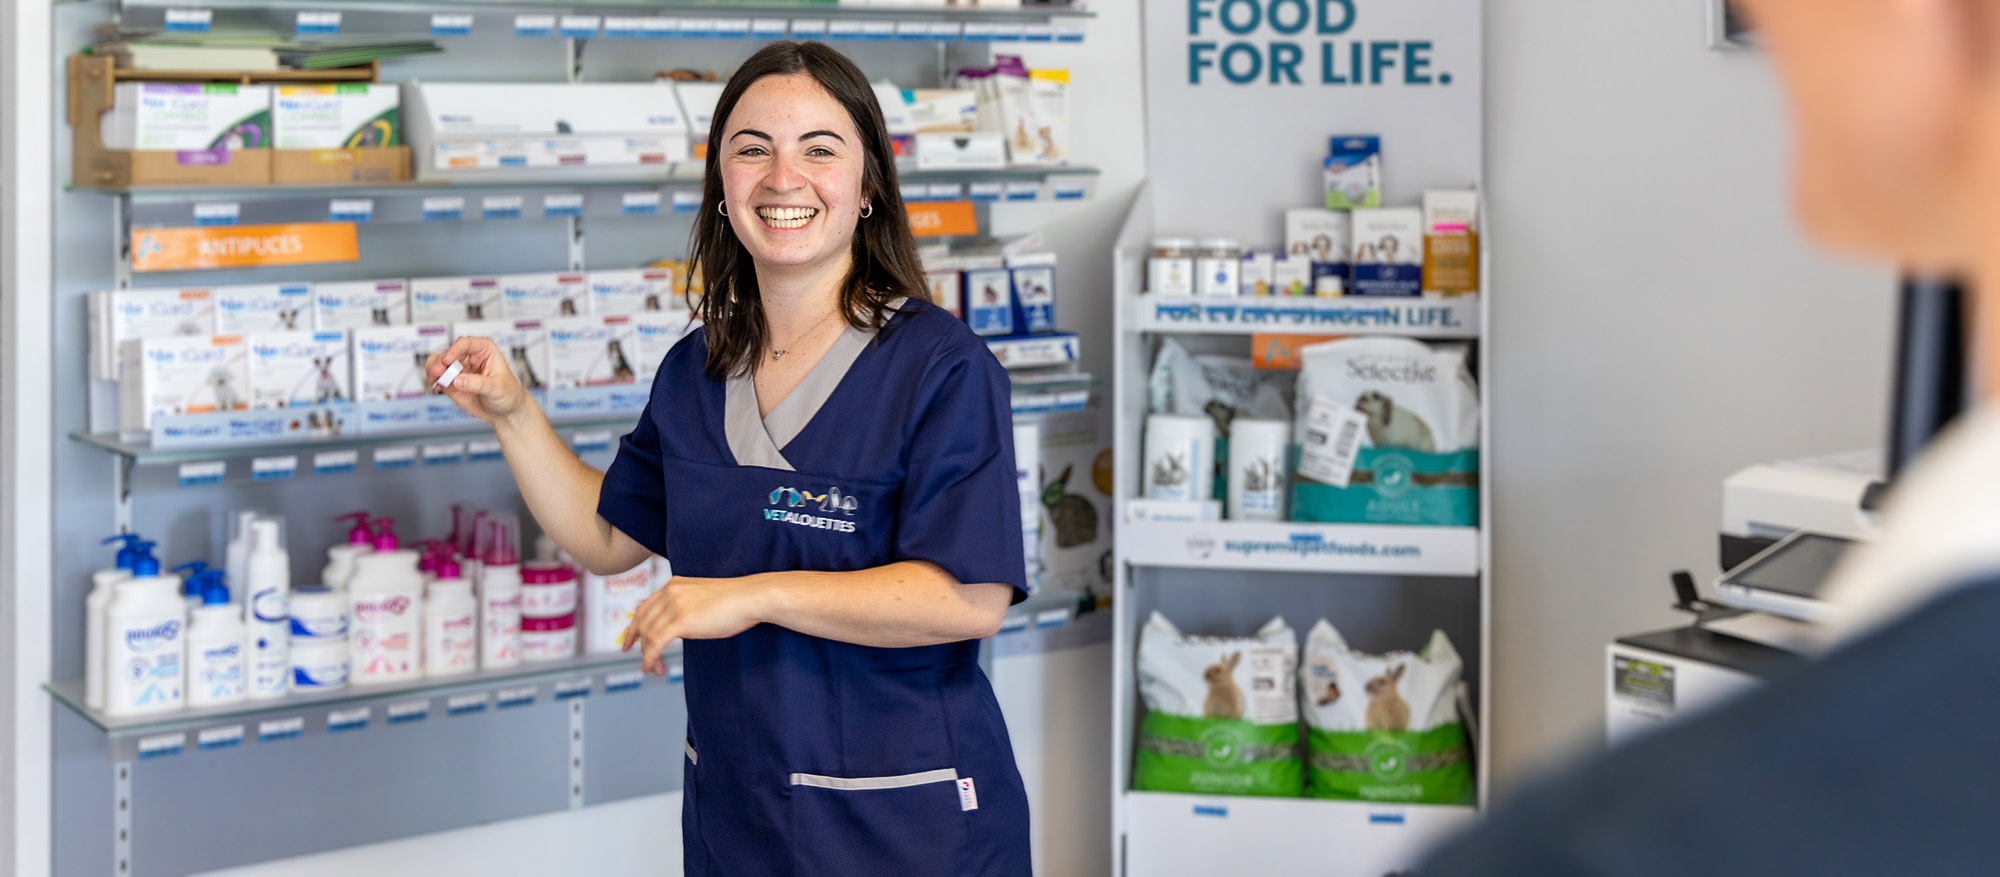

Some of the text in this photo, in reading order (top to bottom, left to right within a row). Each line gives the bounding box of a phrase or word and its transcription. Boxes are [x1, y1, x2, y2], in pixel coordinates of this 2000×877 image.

[1187, 0, 1357, 35] FOOD
[1188, 40, 1453, 85] FOR LIFE.
[198, 234, 304, 257] ANTIPUCES
[1406, 307, 1461, 327] LIFE.
